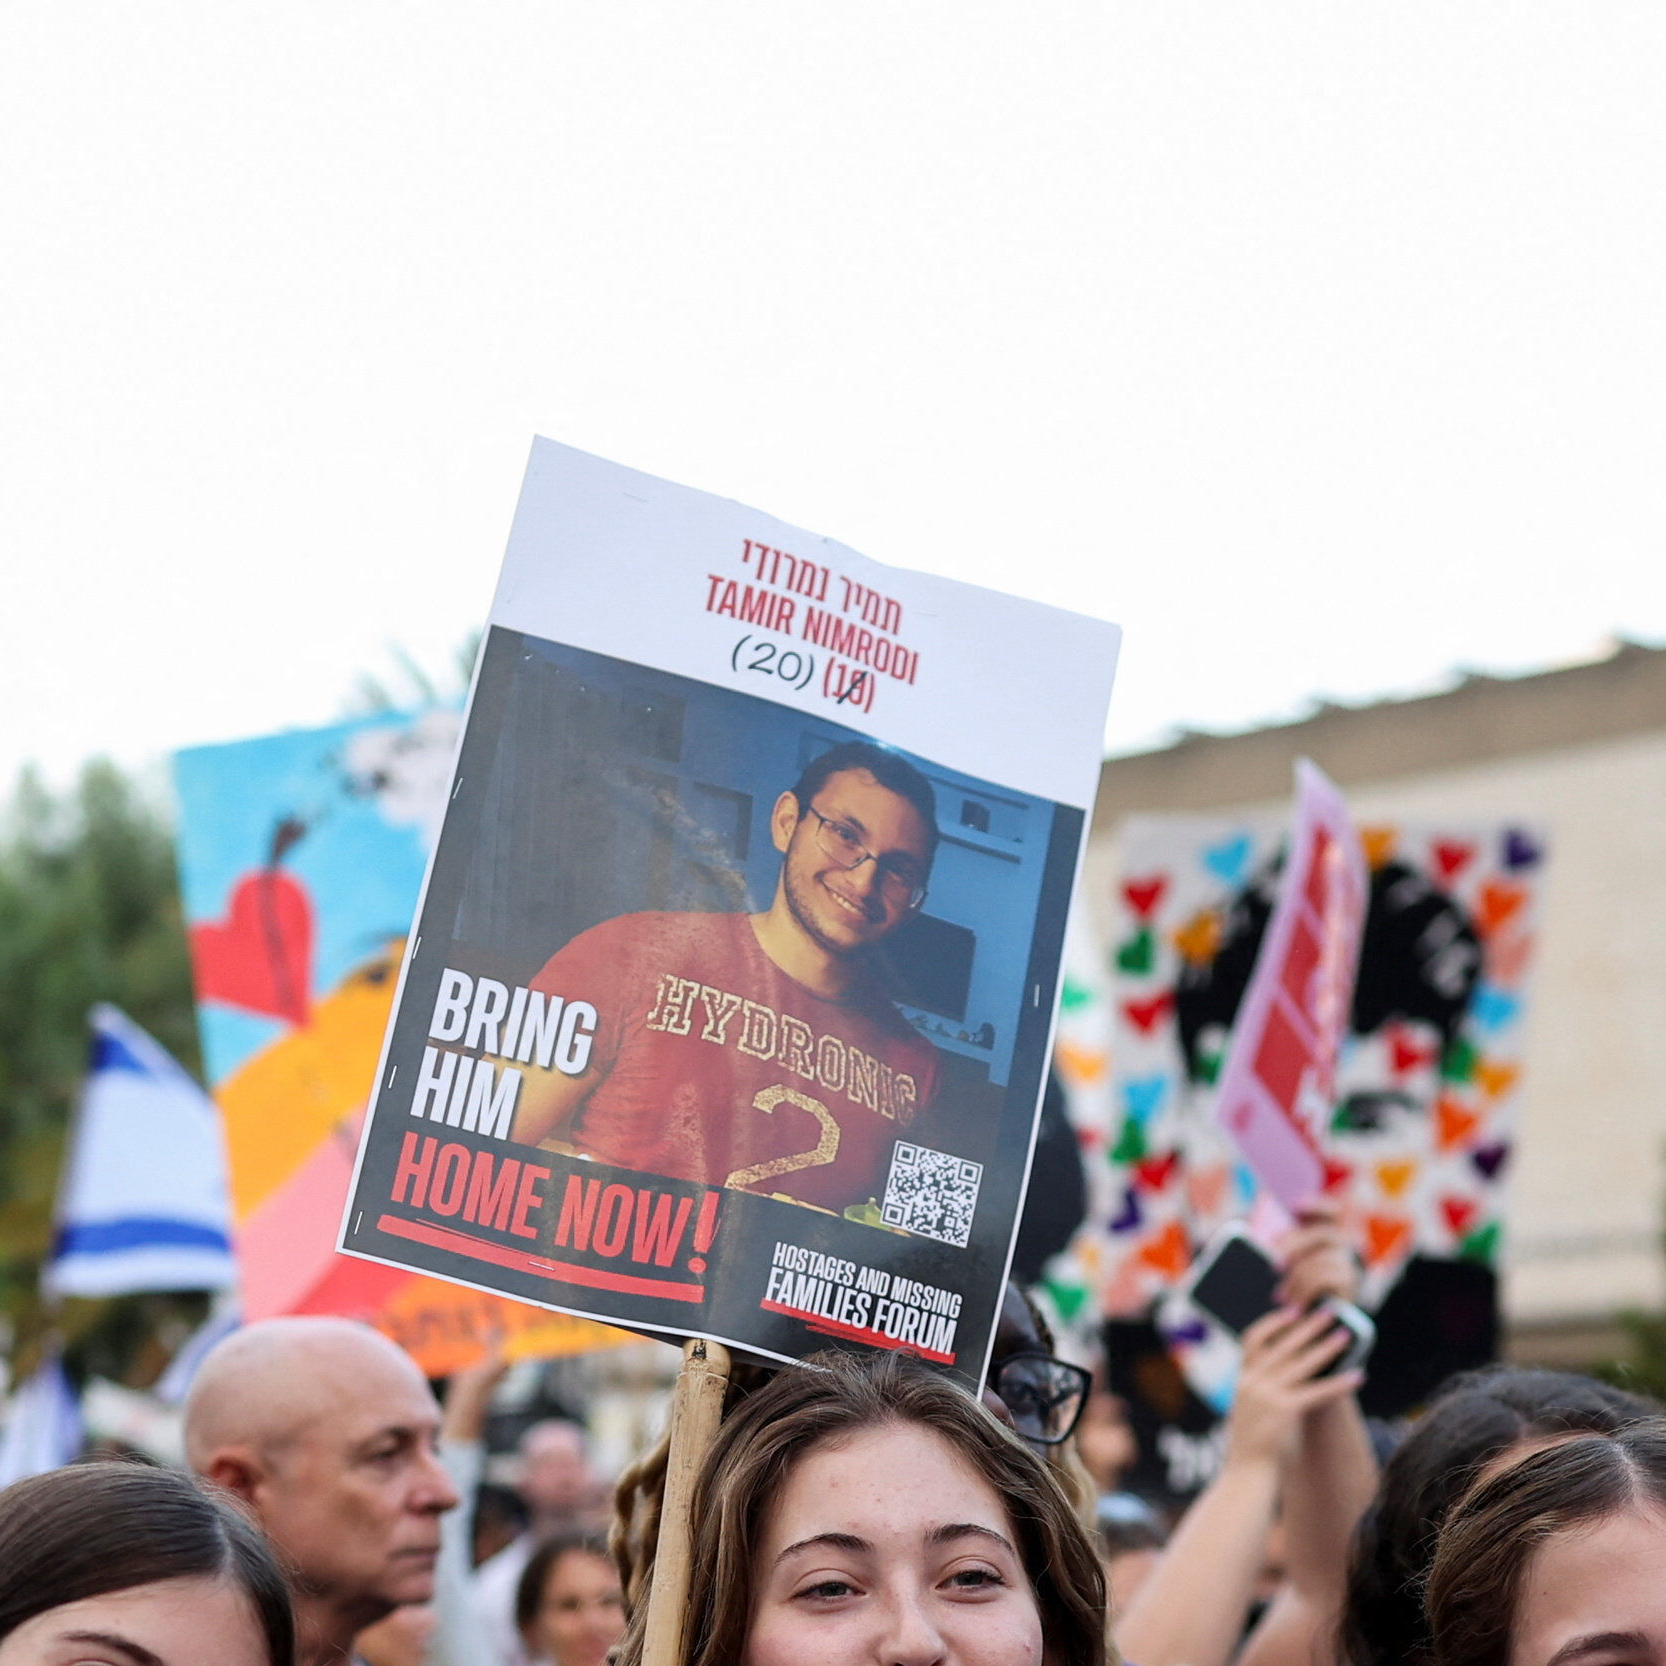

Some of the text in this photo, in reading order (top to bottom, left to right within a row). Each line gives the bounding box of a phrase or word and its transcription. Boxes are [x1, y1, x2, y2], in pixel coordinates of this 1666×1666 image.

[705, 573, 919, 686] TAMIR NIMRODI
[741, 538, 903, 637] תמיר נמרודי
[731, 635, 814, 690] (20)
[428, 967, 598, 1075] BRING
[646, 974, 918, 1126] HYDRONIC
[410, 1045, 523, 1141] HIM
[724, 1083, 841, 1194] 2
[390, 1131, 720, 1274] HOME NOW!
[764, 1267, 959, 1356] FAMILIES FORUM
[772, 1241, 963, 1320] HOSTAGES AND MISSING
